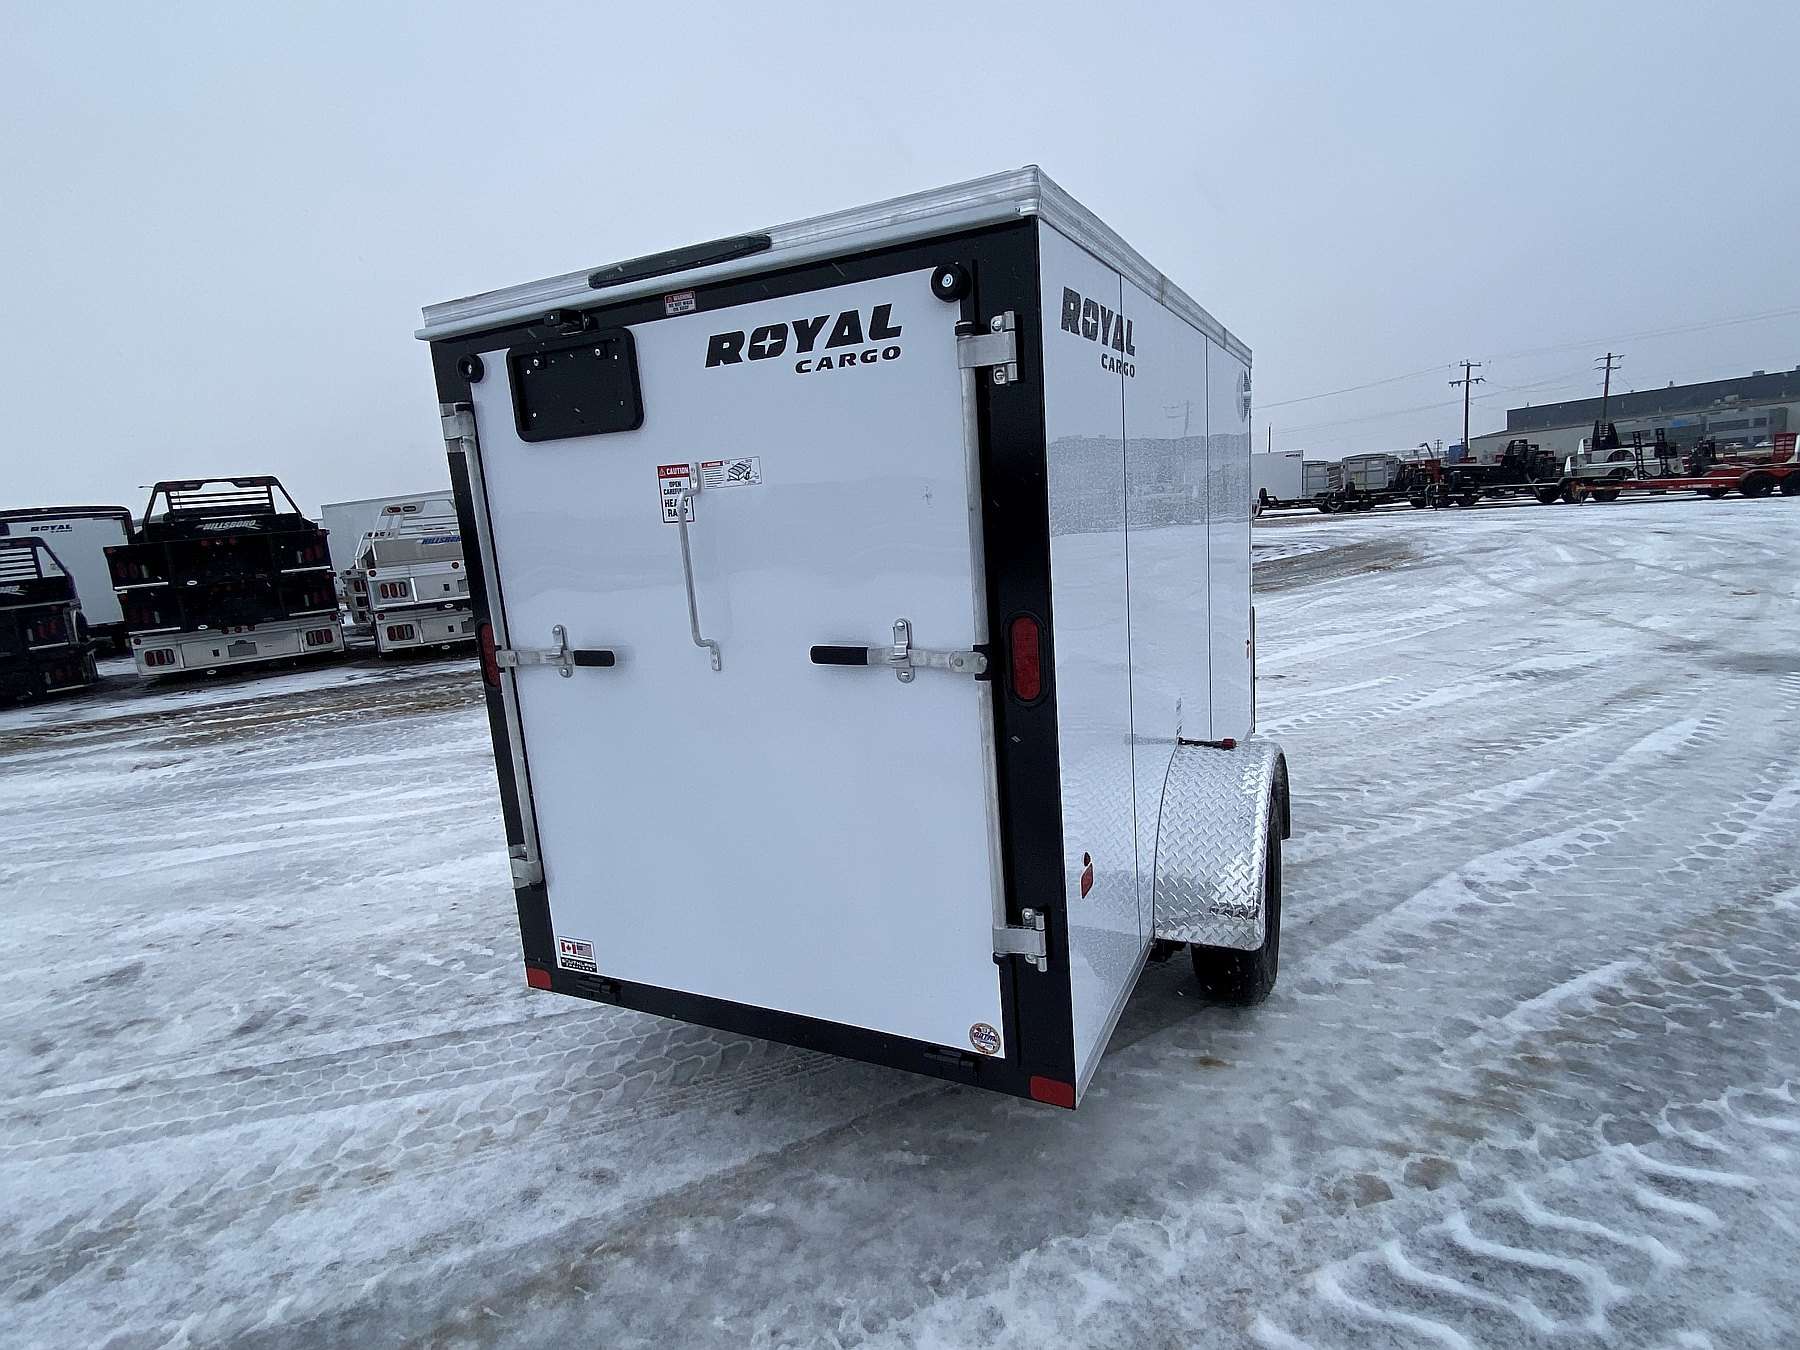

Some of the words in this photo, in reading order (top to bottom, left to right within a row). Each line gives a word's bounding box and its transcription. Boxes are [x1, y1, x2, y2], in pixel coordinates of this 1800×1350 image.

[1061, 286, 1135, 357] ROYAL
[705, 303, 902, 368] ROYAL
[795, 345, 902, 374] CARGO
[1101, 353, 1135, 378] CARGO
[666, 467, 689, 475] CAUTION
[668, 480, 682, 488] OPEN
[664, 497, 689, 507] HEAY
[667, 508, 688, 517] RAP
[31, 524, 72, 532] ROYAL
[203, 520, 257, 531] HILLSBORO
